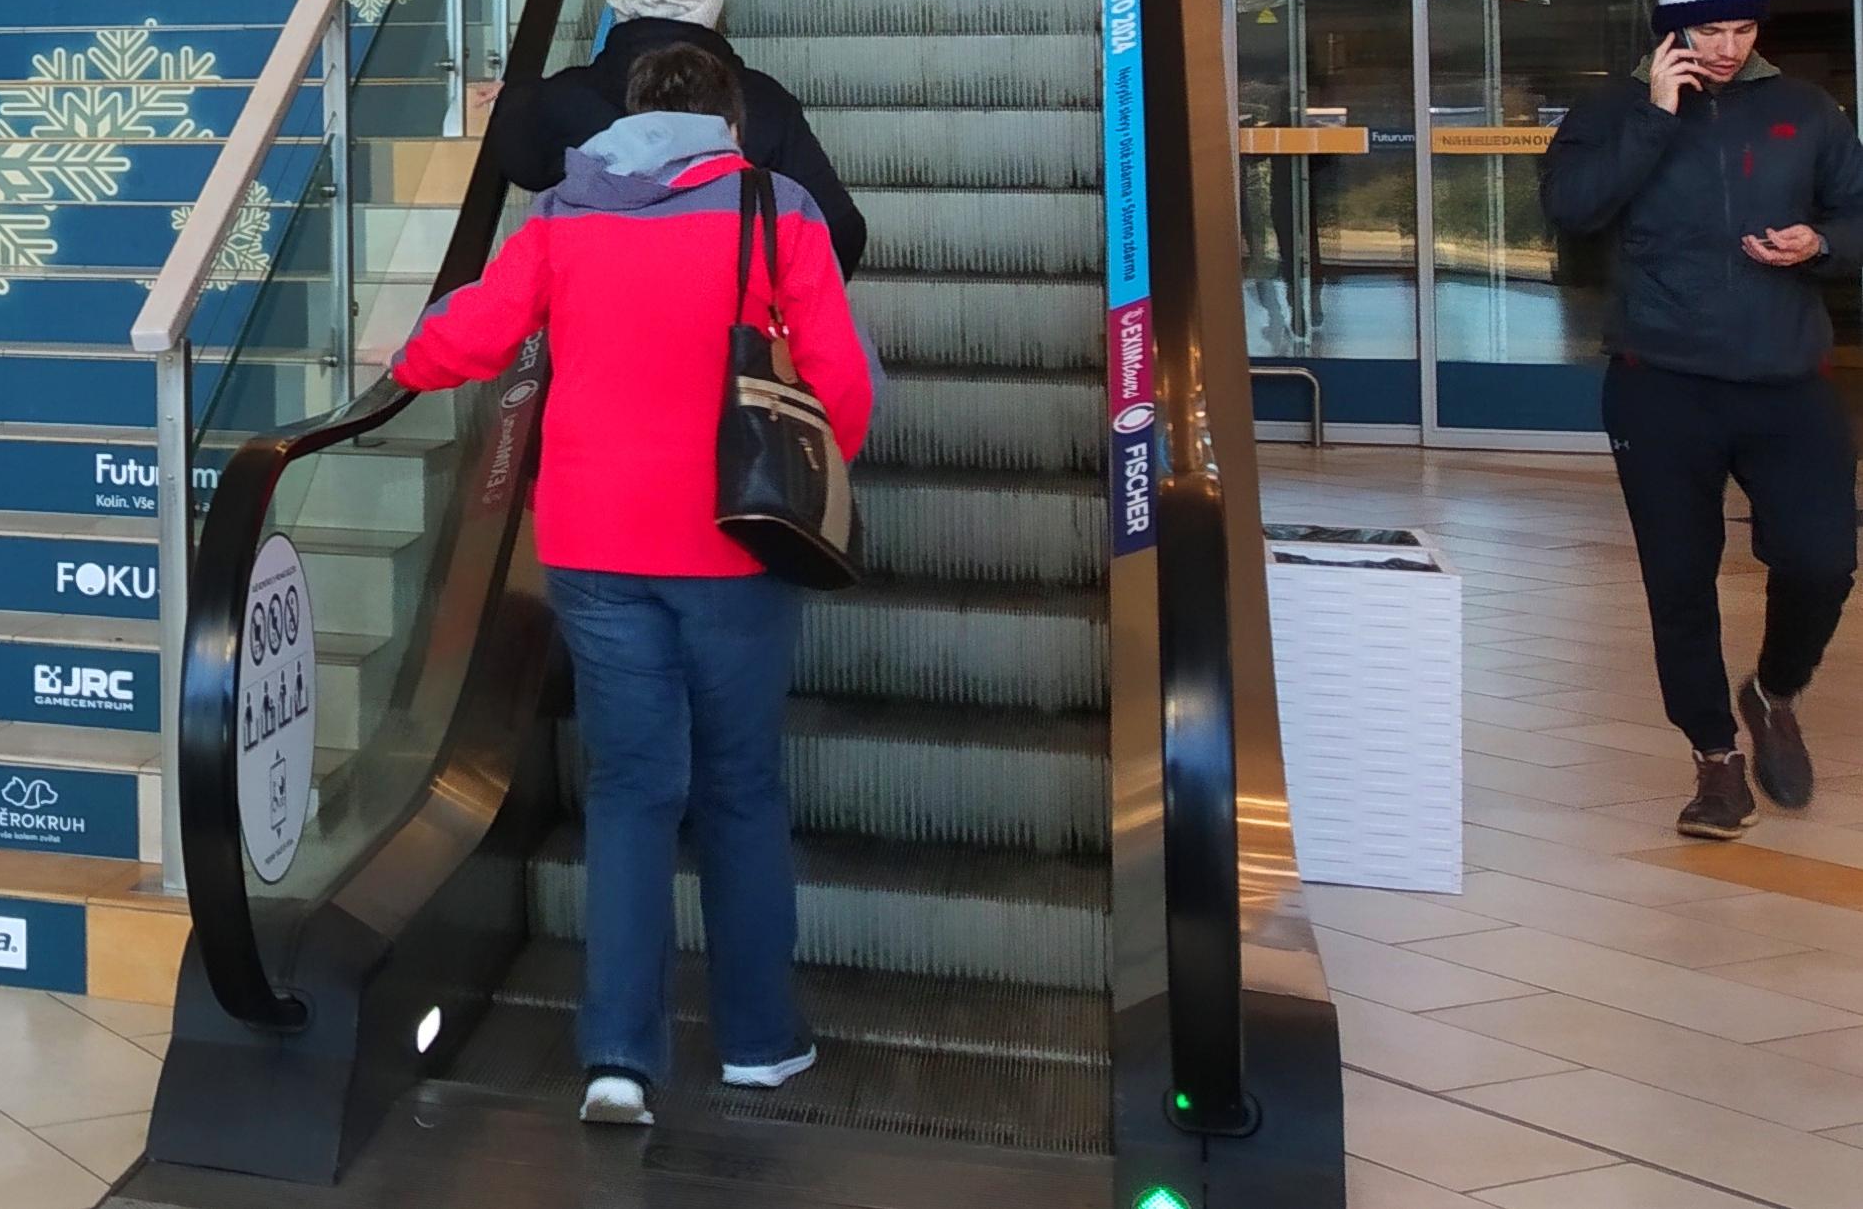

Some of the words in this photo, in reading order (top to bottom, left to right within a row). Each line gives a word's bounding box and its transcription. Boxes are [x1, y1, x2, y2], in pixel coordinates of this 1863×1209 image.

[1111, 12, 1137, 55] 2024
[1372, 131, 1415, 142] Futurum
[1119, 160, 1134, 197] zdarma
[1121, 204, 1136, 240] Storno
[1122, 240, 1137, 282] zdarma
[96, 454, 218, 489] Futum
[1124, 442, 1150, 536] FISCHER
[132, 495, 155, 510] Vše
[57, 563, 159, 599] FOKU
[65, 667, 134, 700] JRC
[34, 695, 134, 712] GAMECENTRUM
